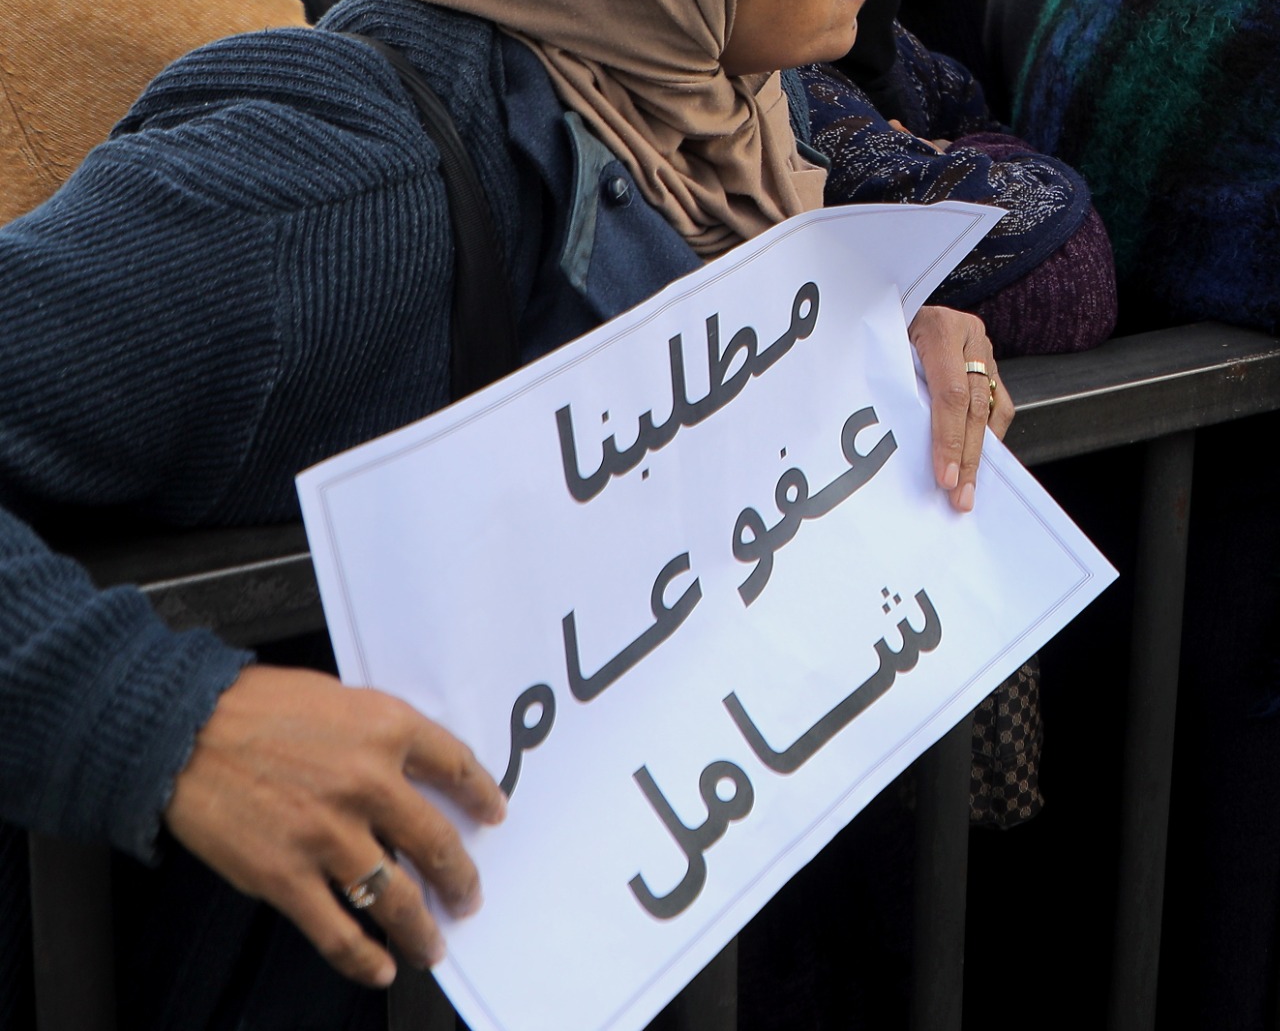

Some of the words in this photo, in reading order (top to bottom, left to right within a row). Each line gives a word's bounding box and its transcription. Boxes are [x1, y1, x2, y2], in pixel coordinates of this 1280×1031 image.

[554, 280, 821, 504] مطلبنا
[731, 405, 899, 608] عفو
[501, 550, 703, 798] عام
[627, 584, 944, 921] شامل
